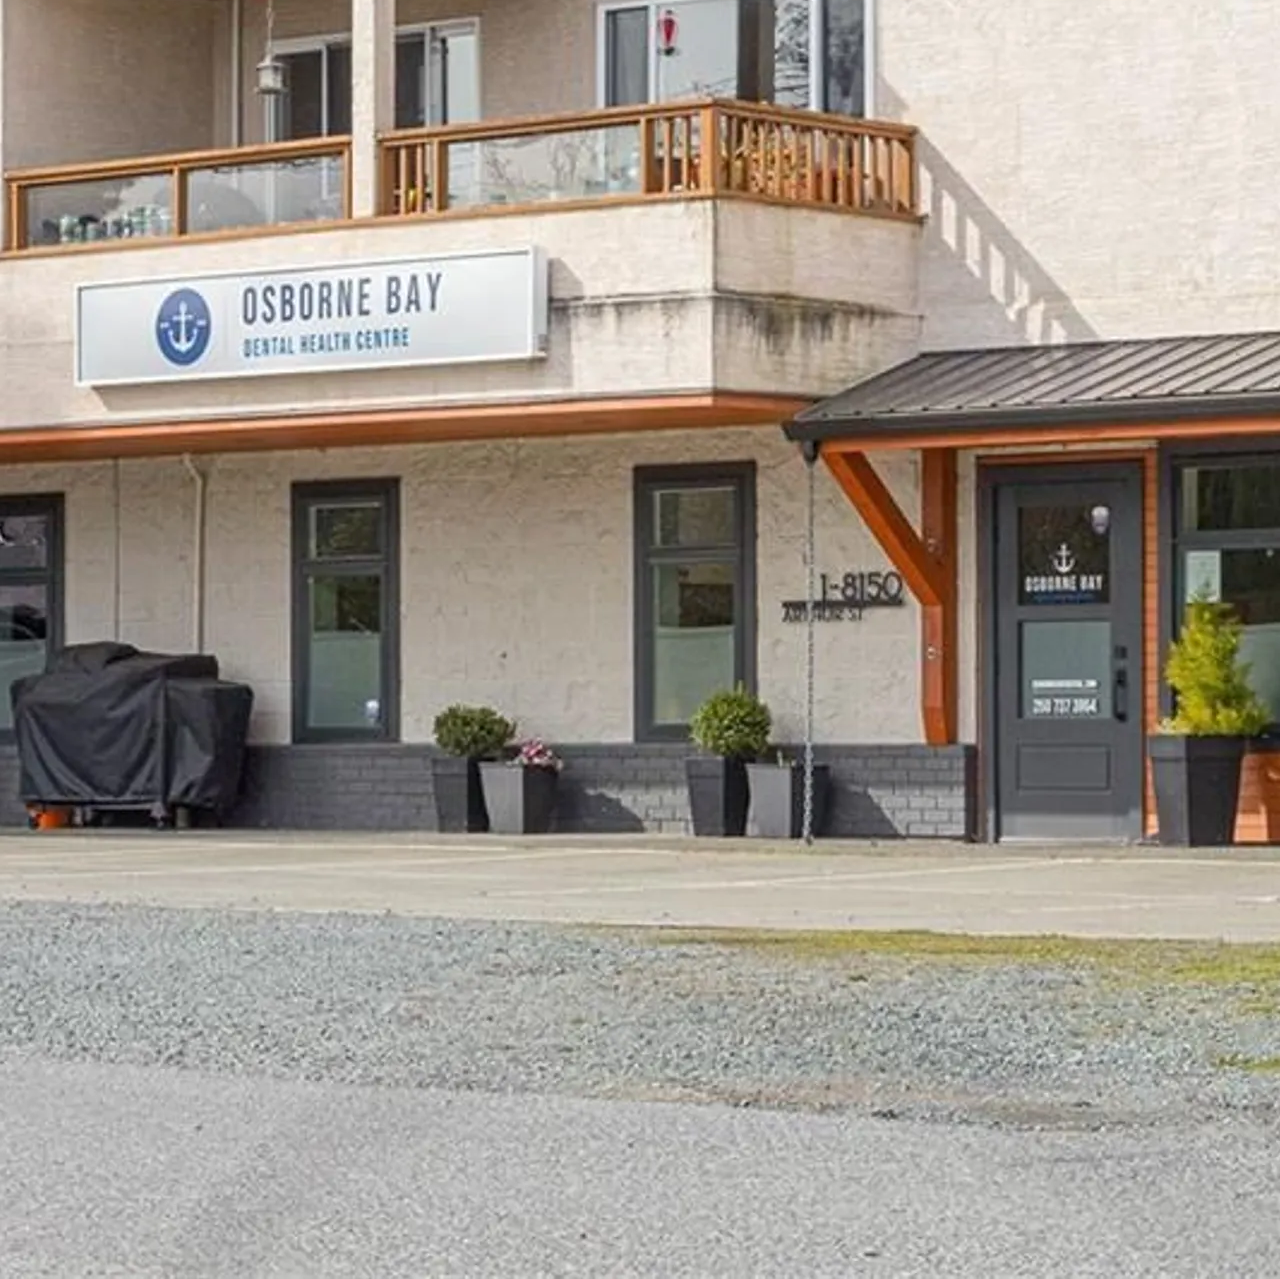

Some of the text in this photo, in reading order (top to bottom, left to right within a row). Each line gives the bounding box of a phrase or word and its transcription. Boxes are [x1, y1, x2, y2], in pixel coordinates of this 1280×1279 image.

[242, 272, 442, 325] OSBORNE BAY
[243, 327, 409, 358] DENTAL HEALTH CENTRE
[1080, 574, 1103, 591] BAY
